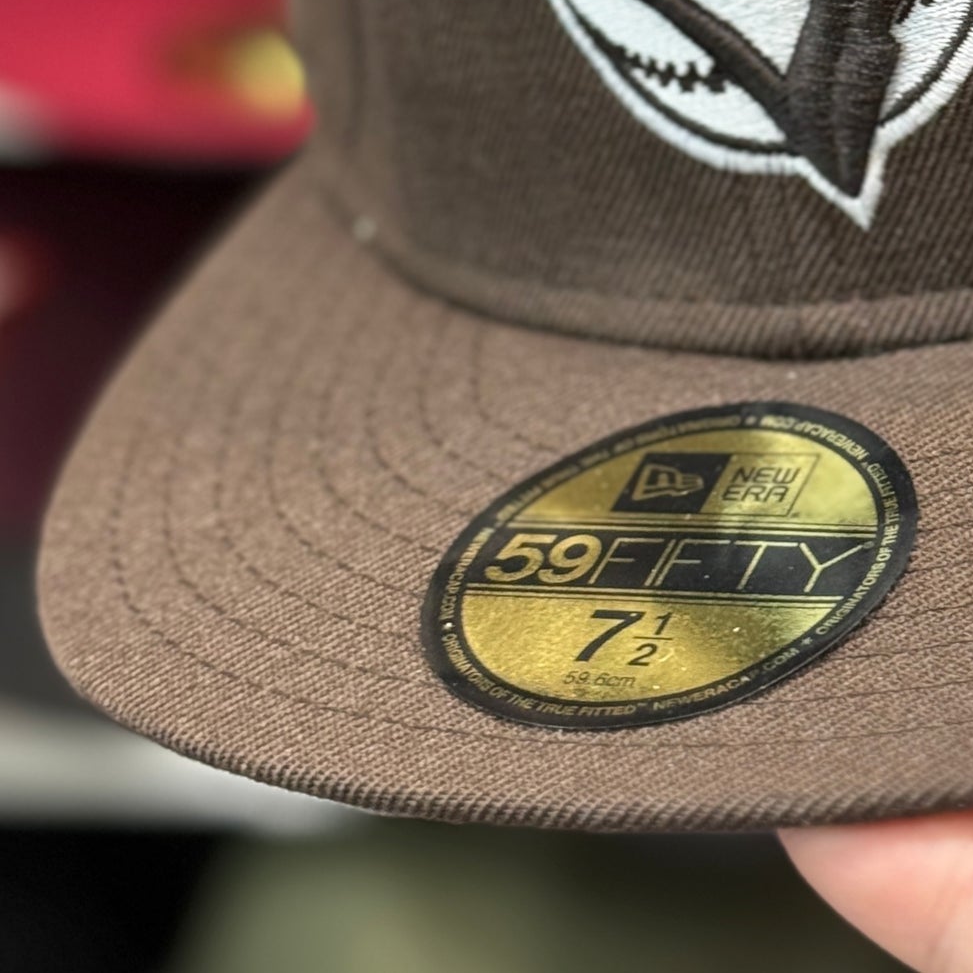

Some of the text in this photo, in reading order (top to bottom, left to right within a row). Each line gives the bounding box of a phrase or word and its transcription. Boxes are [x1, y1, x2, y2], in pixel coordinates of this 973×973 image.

[731, 466, 800, 485] NEW
[721, 485, 788, 503] ERA
[881, 524, 900, 546] THE
[484, 533, 864, 593] 59FIFTY
[876, 546, 893, 563] OF
[815, 561, 887, 636] ORIGINATORS
[574, 609, 646, 662] 7
[441, 633, 491, 693] ORIGINATORS
[488, 683, 511, 700] OF
[506, 694, 537, 710] THE
[536, 700, 575, 715] TRUE
[563, 670, 636, 687] 59.6cm
